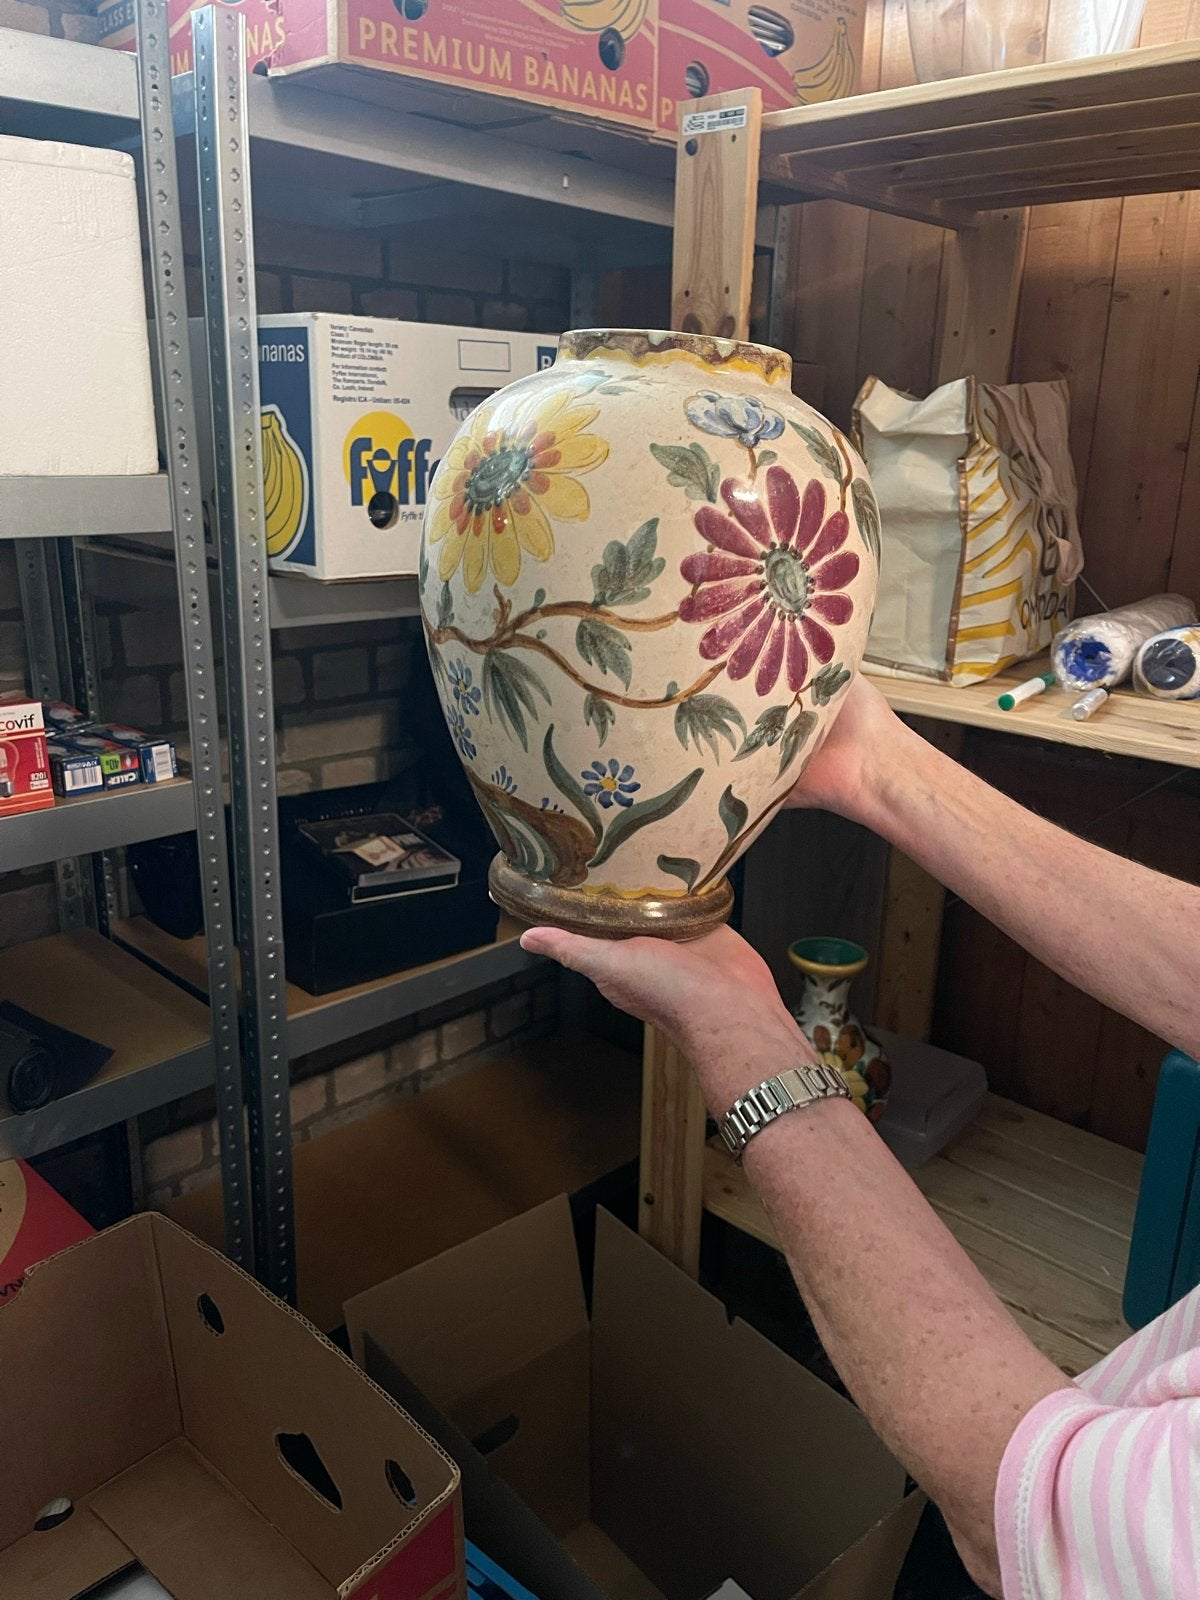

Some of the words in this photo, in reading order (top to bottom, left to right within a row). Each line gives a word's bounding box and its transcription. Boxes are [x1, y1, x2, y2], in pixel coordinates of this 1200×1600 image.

[359, 17, 512, 82] PREMIUM
[524, 55, 649, 113] BANANAS
[260, 344, 305, 362] nanas
[107, 771, 138, 786] CALEX
